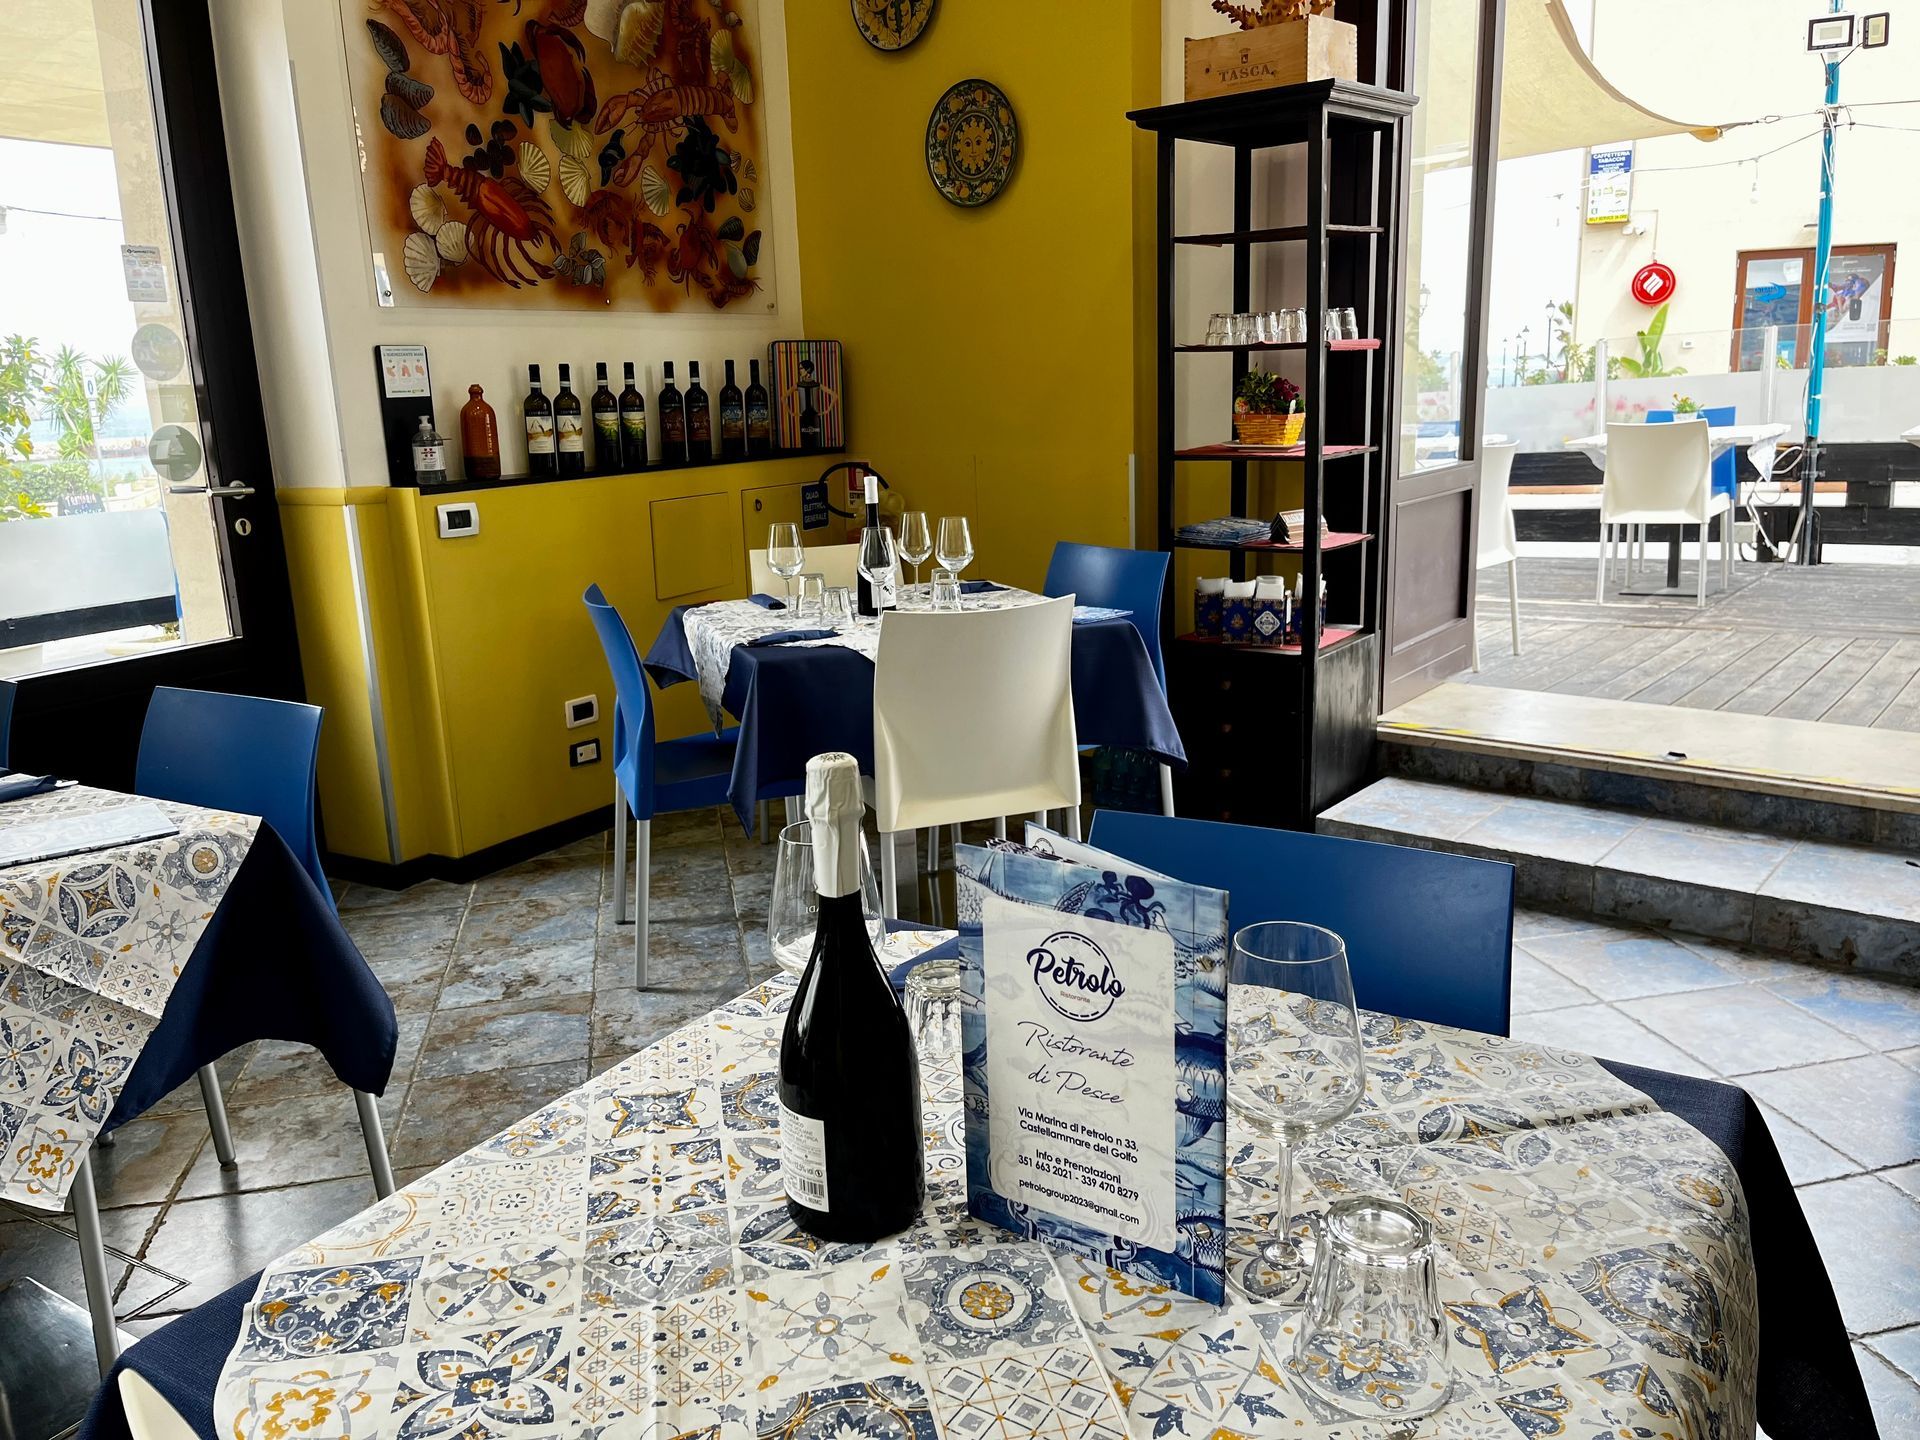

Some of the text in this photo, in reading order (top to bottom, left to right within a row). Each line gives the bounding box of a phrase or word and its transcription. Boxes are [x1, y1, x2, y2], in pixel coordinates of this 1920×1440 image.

[1218, 64, 1271, 82] TASCA
[1593, 151, 1630, 159] CAFFETTERIA
[804, 512, 827, 524] GENERALE
[1026, 947, 1126, 998] Petrolo
[1060, 990, 1091, 1004] Ristorante
[1017, 1021, 1135, 1067] Ristorante
[1028, 1063, 1124, 1104] di Pesce
[1018, 1106, 1139, 1152] Via Marina di Petrolo n 33,
[1019, 1120, 1138, 1164] Castellammare del Golfo
[1018, 1155, 1033, 1167] 351
[1035, 1161, 1051, 1173] 663
[1052, 1166, 1072, 1180] 2021
[1081, 1175, 1097, 1187] 339
[1099, 1181, 1115, 1194] 470
[1117, 1186, 1139, 1201] 8279
[1036, 1149, 1121, 1184] Info e Prenotazioni
[1019, 1179, 1140, 1225] petrologroup2023@gmail.com
